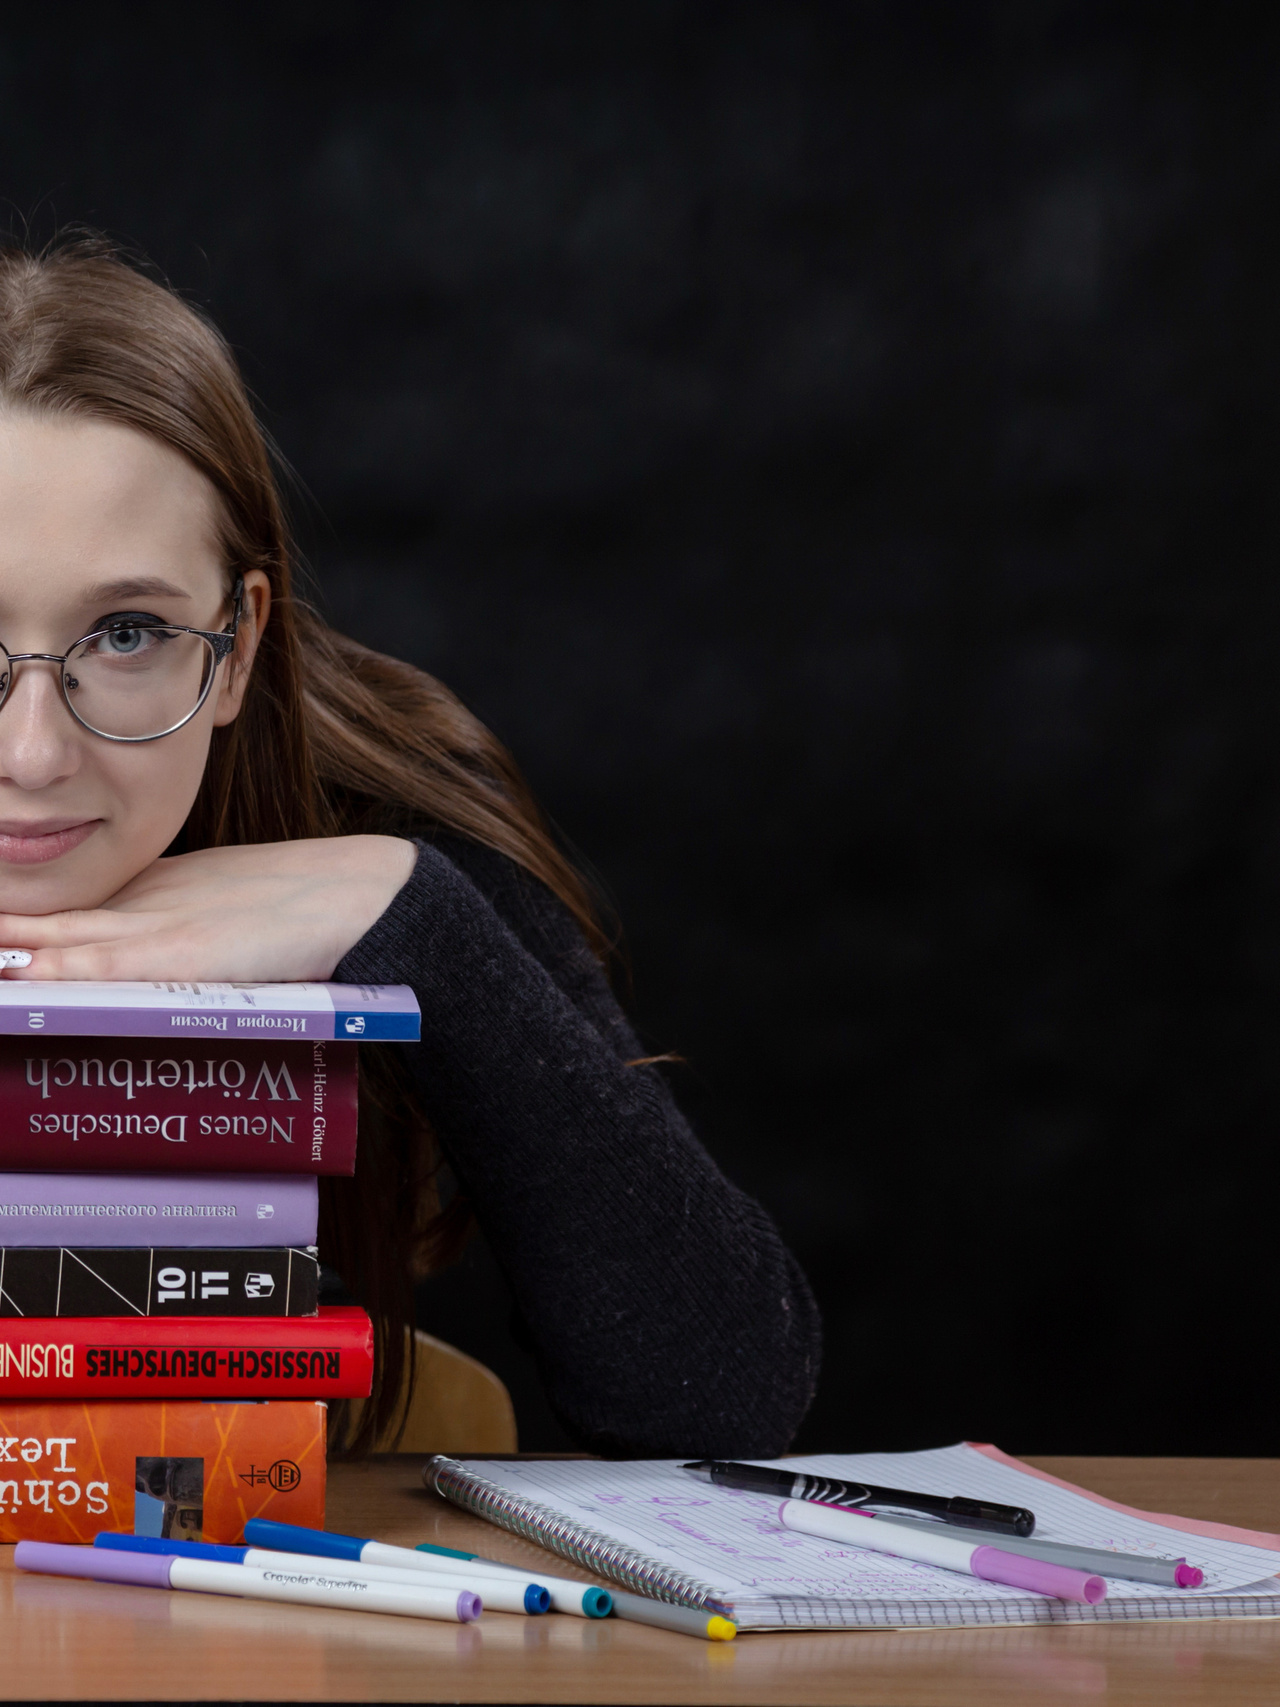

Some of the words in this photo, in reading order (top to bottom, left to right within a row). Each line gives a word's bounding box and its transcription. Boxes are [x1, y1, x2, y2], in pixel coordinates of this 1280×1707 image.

[28, 1011, 45, 1029] 10
[170, 1015, 228, 1031] России
[236, 1017, 307, 1032] История
[24, 1058, 302, 1101] Wörterbuch
[313, 1040, 327, 1113] Karl-Heinz
[29, 1113, 188, 1143] Deutsches
[200, 1115, 296, 1144] Neues
[311, 1116, 327, 1162] Göttert
[161, 1204, 238, 1218] анализа
[157, 1267, 187, 1303] 10
[201, 1271, 230, 1300] 11
[86, 1349, 341, 1380] RUSSISCH-DEUTSCHES
